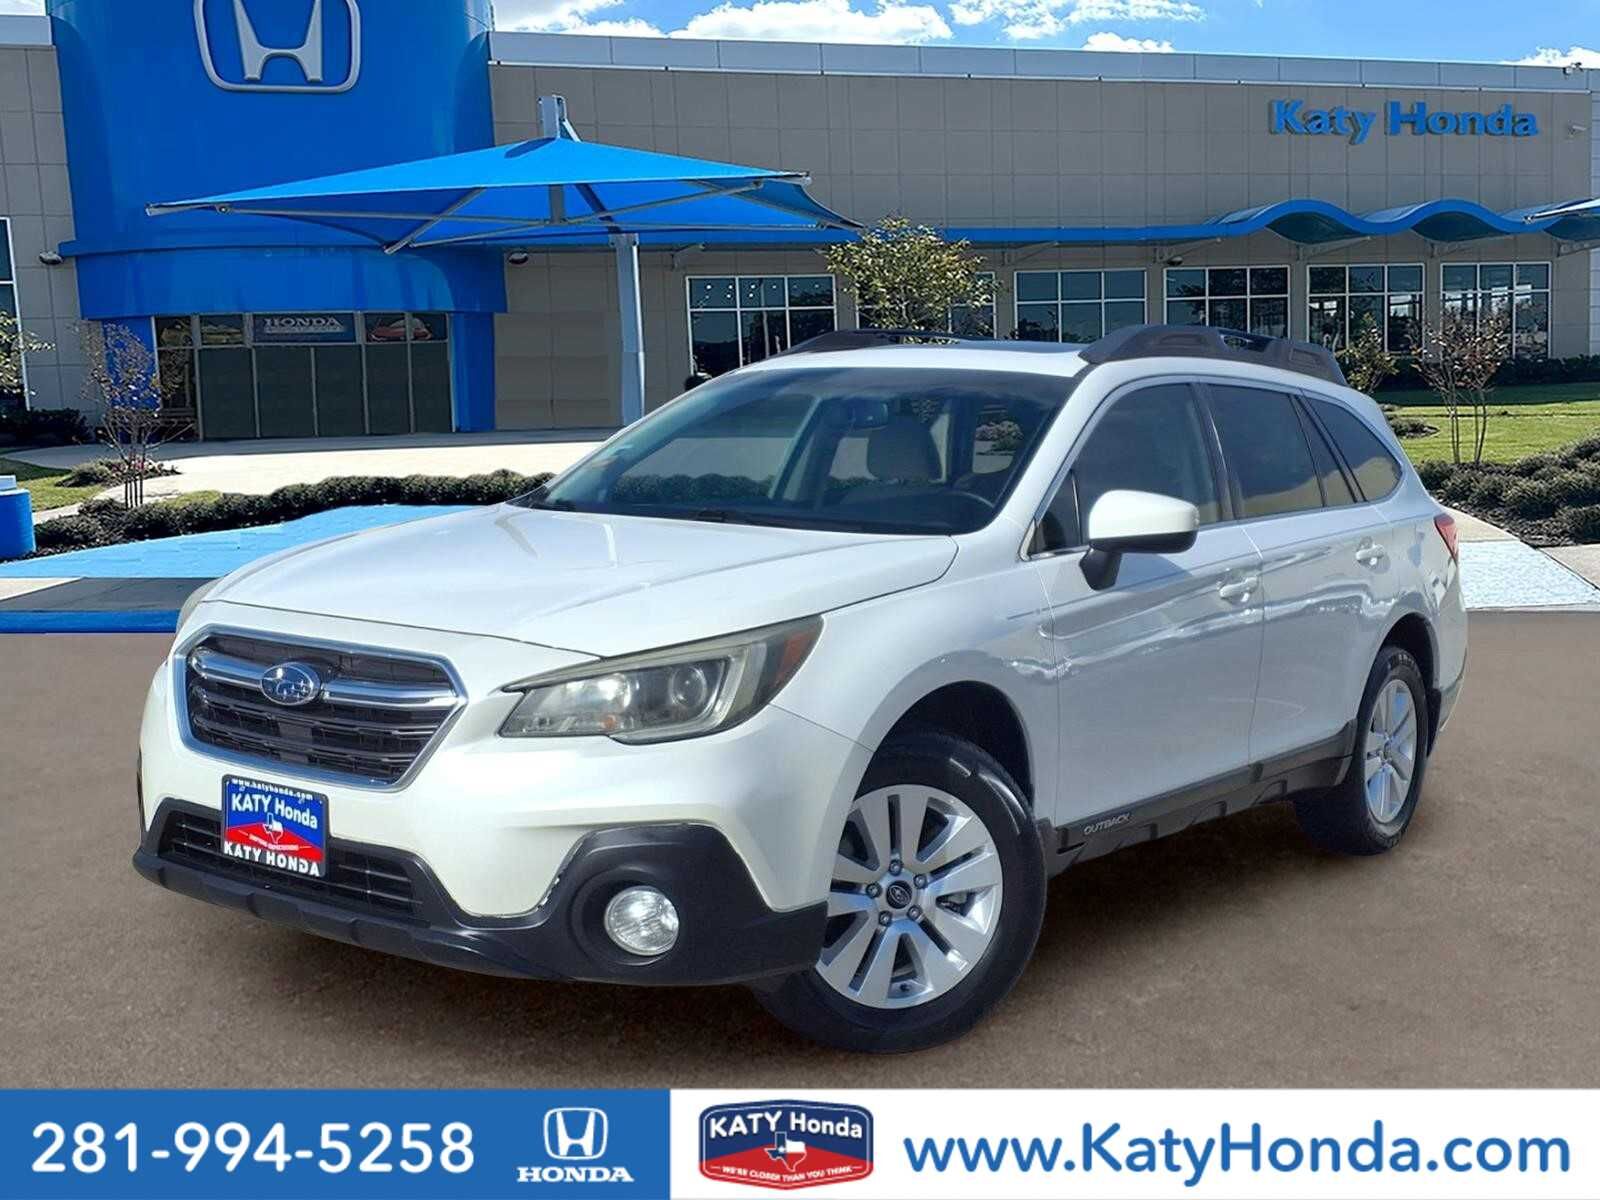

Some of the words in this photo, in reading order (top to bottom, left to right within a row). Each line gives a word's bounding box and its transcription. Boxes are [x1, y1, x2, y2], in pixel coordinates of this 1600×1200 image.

[1271, 100, 1377, 144] Katy
[1387, 101, 1538, 136] Honda
[263, 316, 344, 329] HONDA
[231, 792, 272, 812] KATY
[275, 798, 318, 829] Honda
[1083, 812, 1131, 835] OUTBACK
[223, 840, 262, 862] KATY
[265, 850, 320, 877] HONDA
